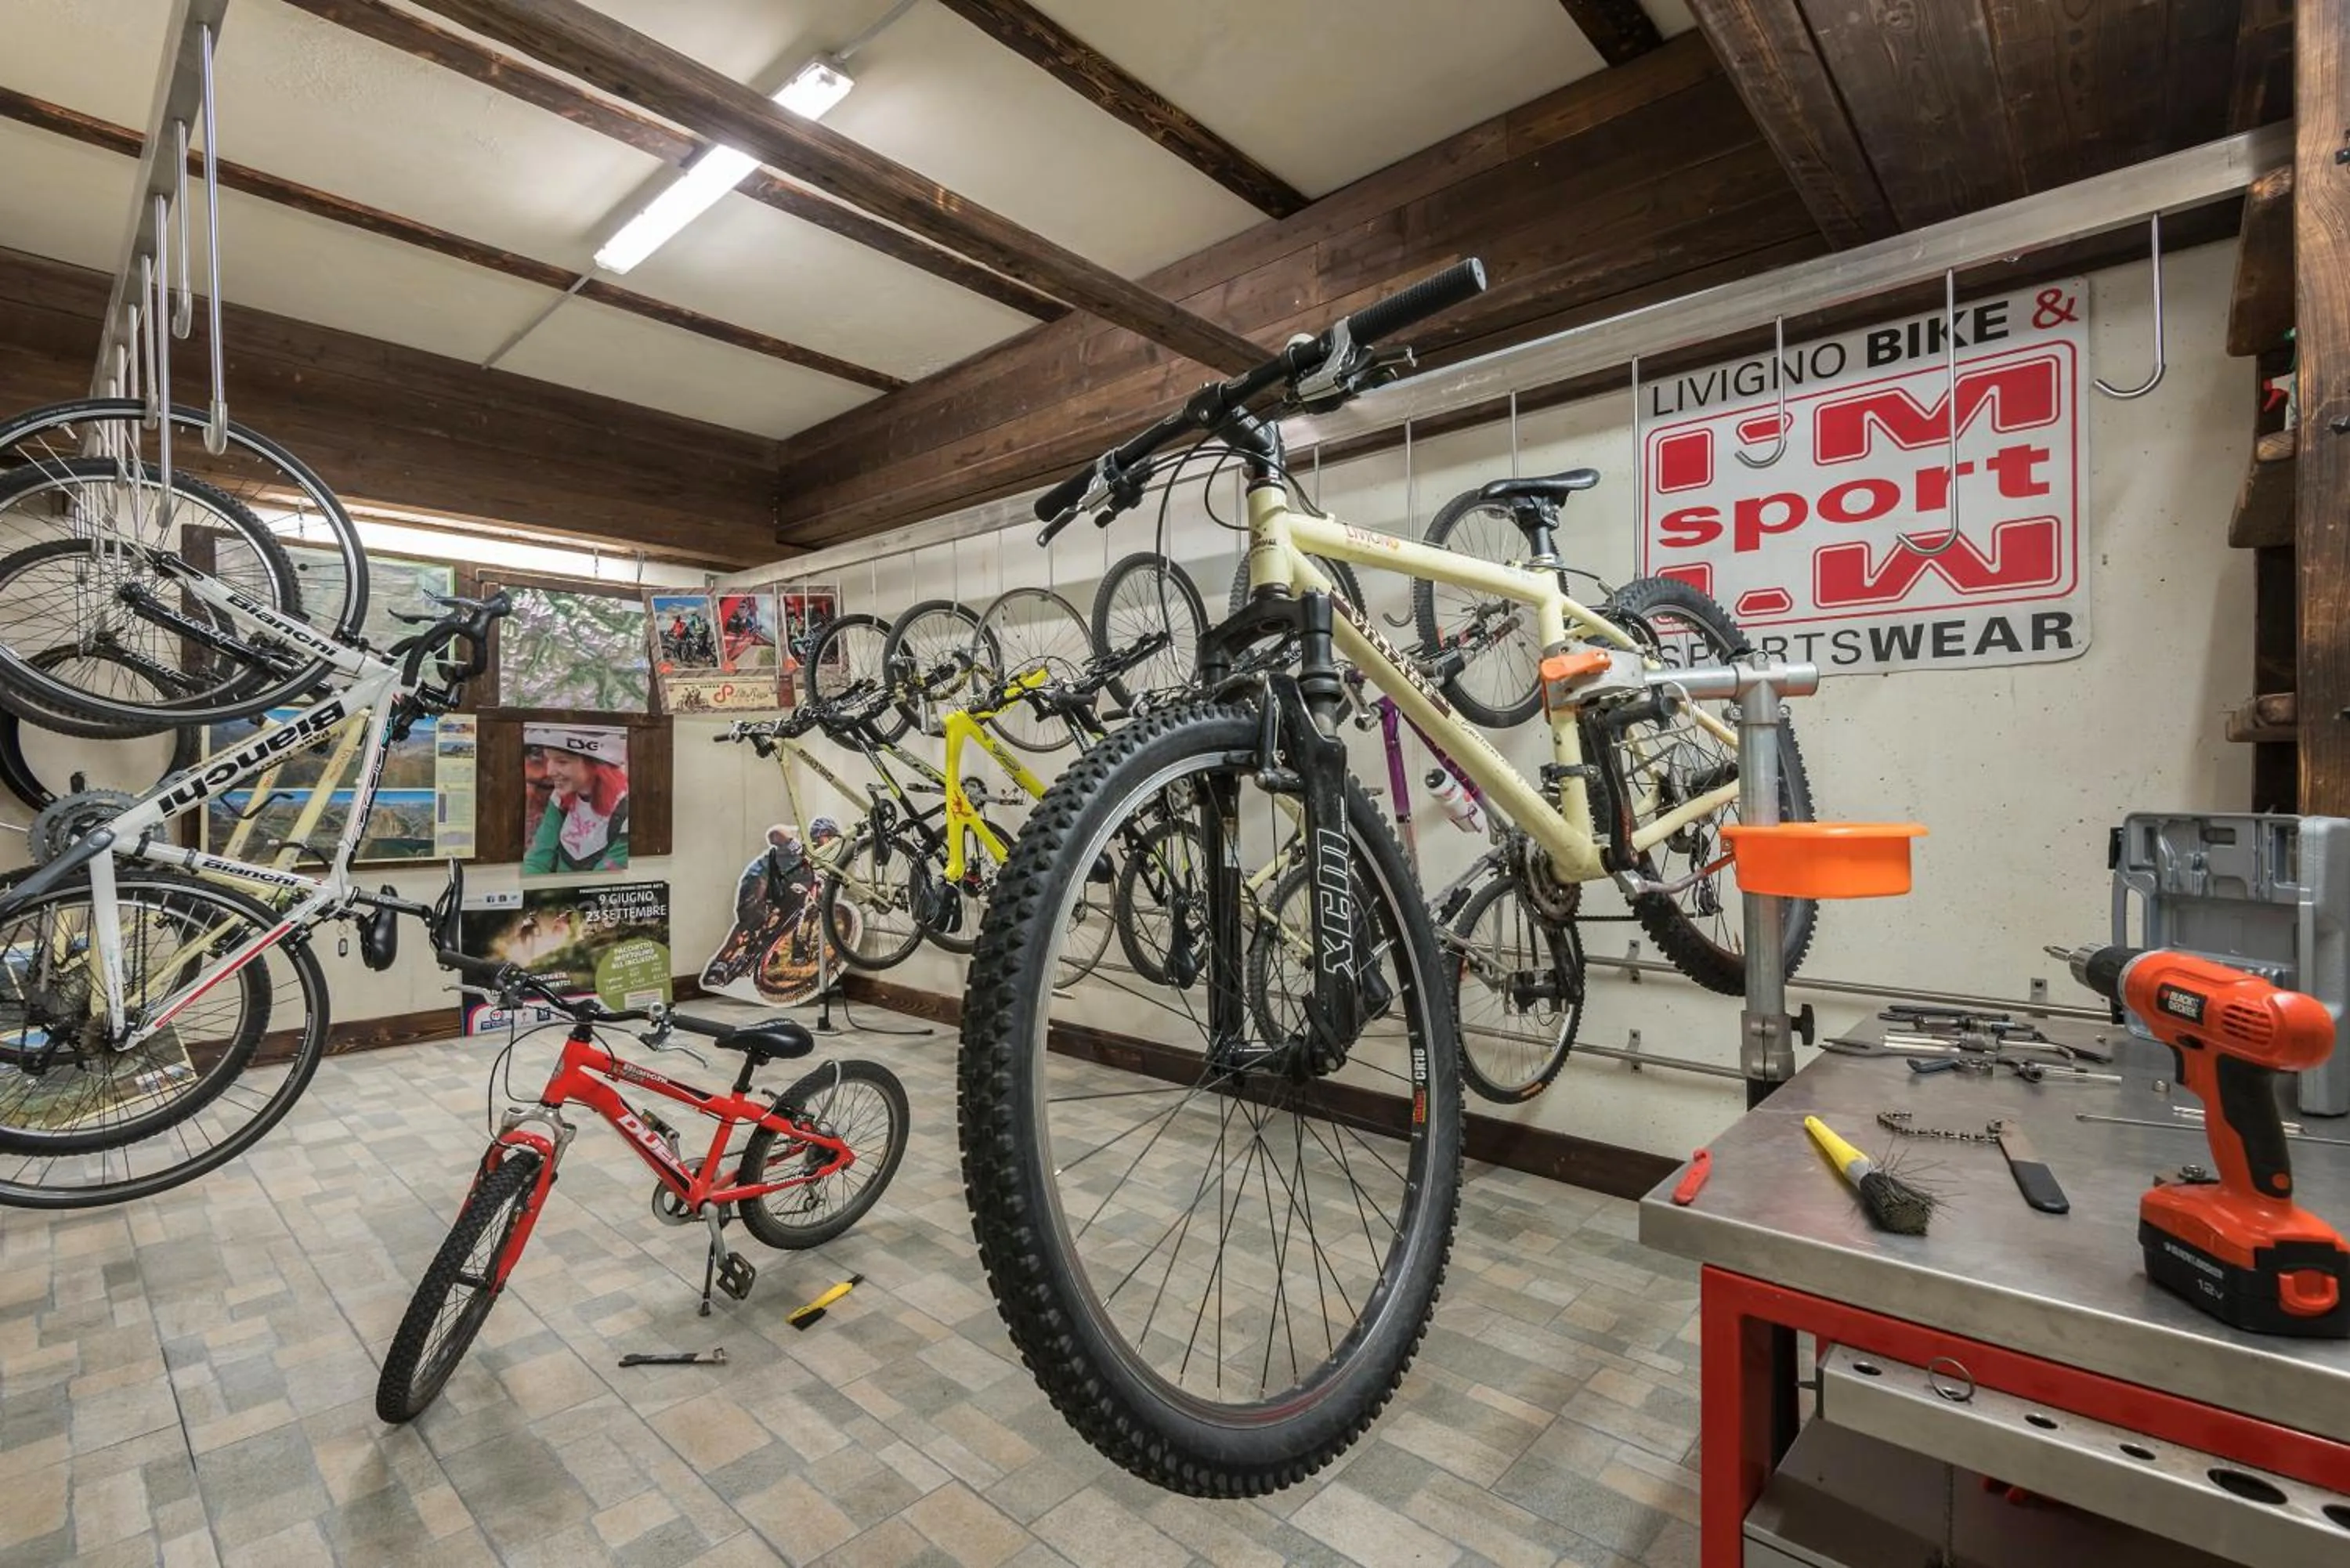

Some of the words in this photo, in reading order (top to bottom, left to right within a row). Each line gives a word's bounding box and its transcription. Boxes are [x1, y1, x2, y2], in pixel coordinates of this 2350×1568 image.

[1653, 342, 1846, 417] LIVIGNO
[1867, 300, 2009, 369] BIKE
[2031, 287, 2080, 331] &
[1658, 443, 2051, 554] sport
[226, 593, 339, 658] Bianchi
[1660, 612, 2073, 668] SPRTSWEAR
[157, 701, 346, 818] Bianchi
[202, 858, 301, 887] Bianchi
[598, 894, 606, 905] 9
[609, 891, 654, 905] GIUGNO
[585, 910, 601, 923] 23
[602, 905, 667, 921] SETTEMBRE
[1317, 828, 1356, 980] XCM
[624, 1063, 668, 1084] Bianchi
